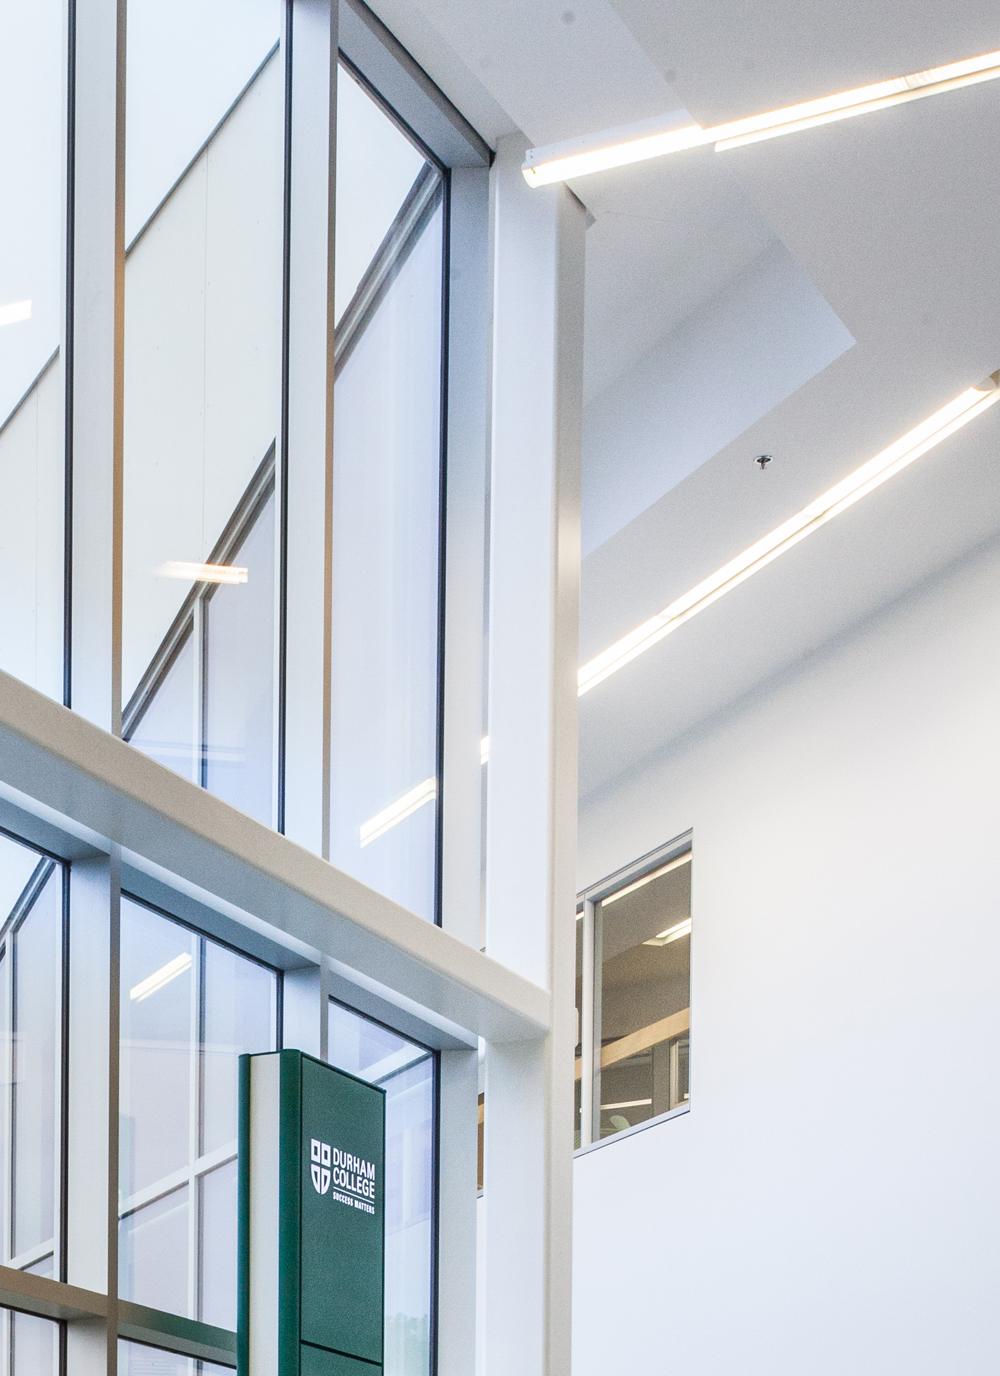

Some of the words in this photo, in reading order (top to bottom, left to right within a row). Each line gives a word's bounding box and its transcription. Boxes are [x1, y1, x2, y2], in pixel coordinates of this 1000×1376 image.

[333, 1148, 375, 1181] DURHAM
[333, 1167, 375, 1199] COLLEGE
[333, 1191, 353, 1206] SUCCESS
[354, 1200, 375, 1215] MATTERS
